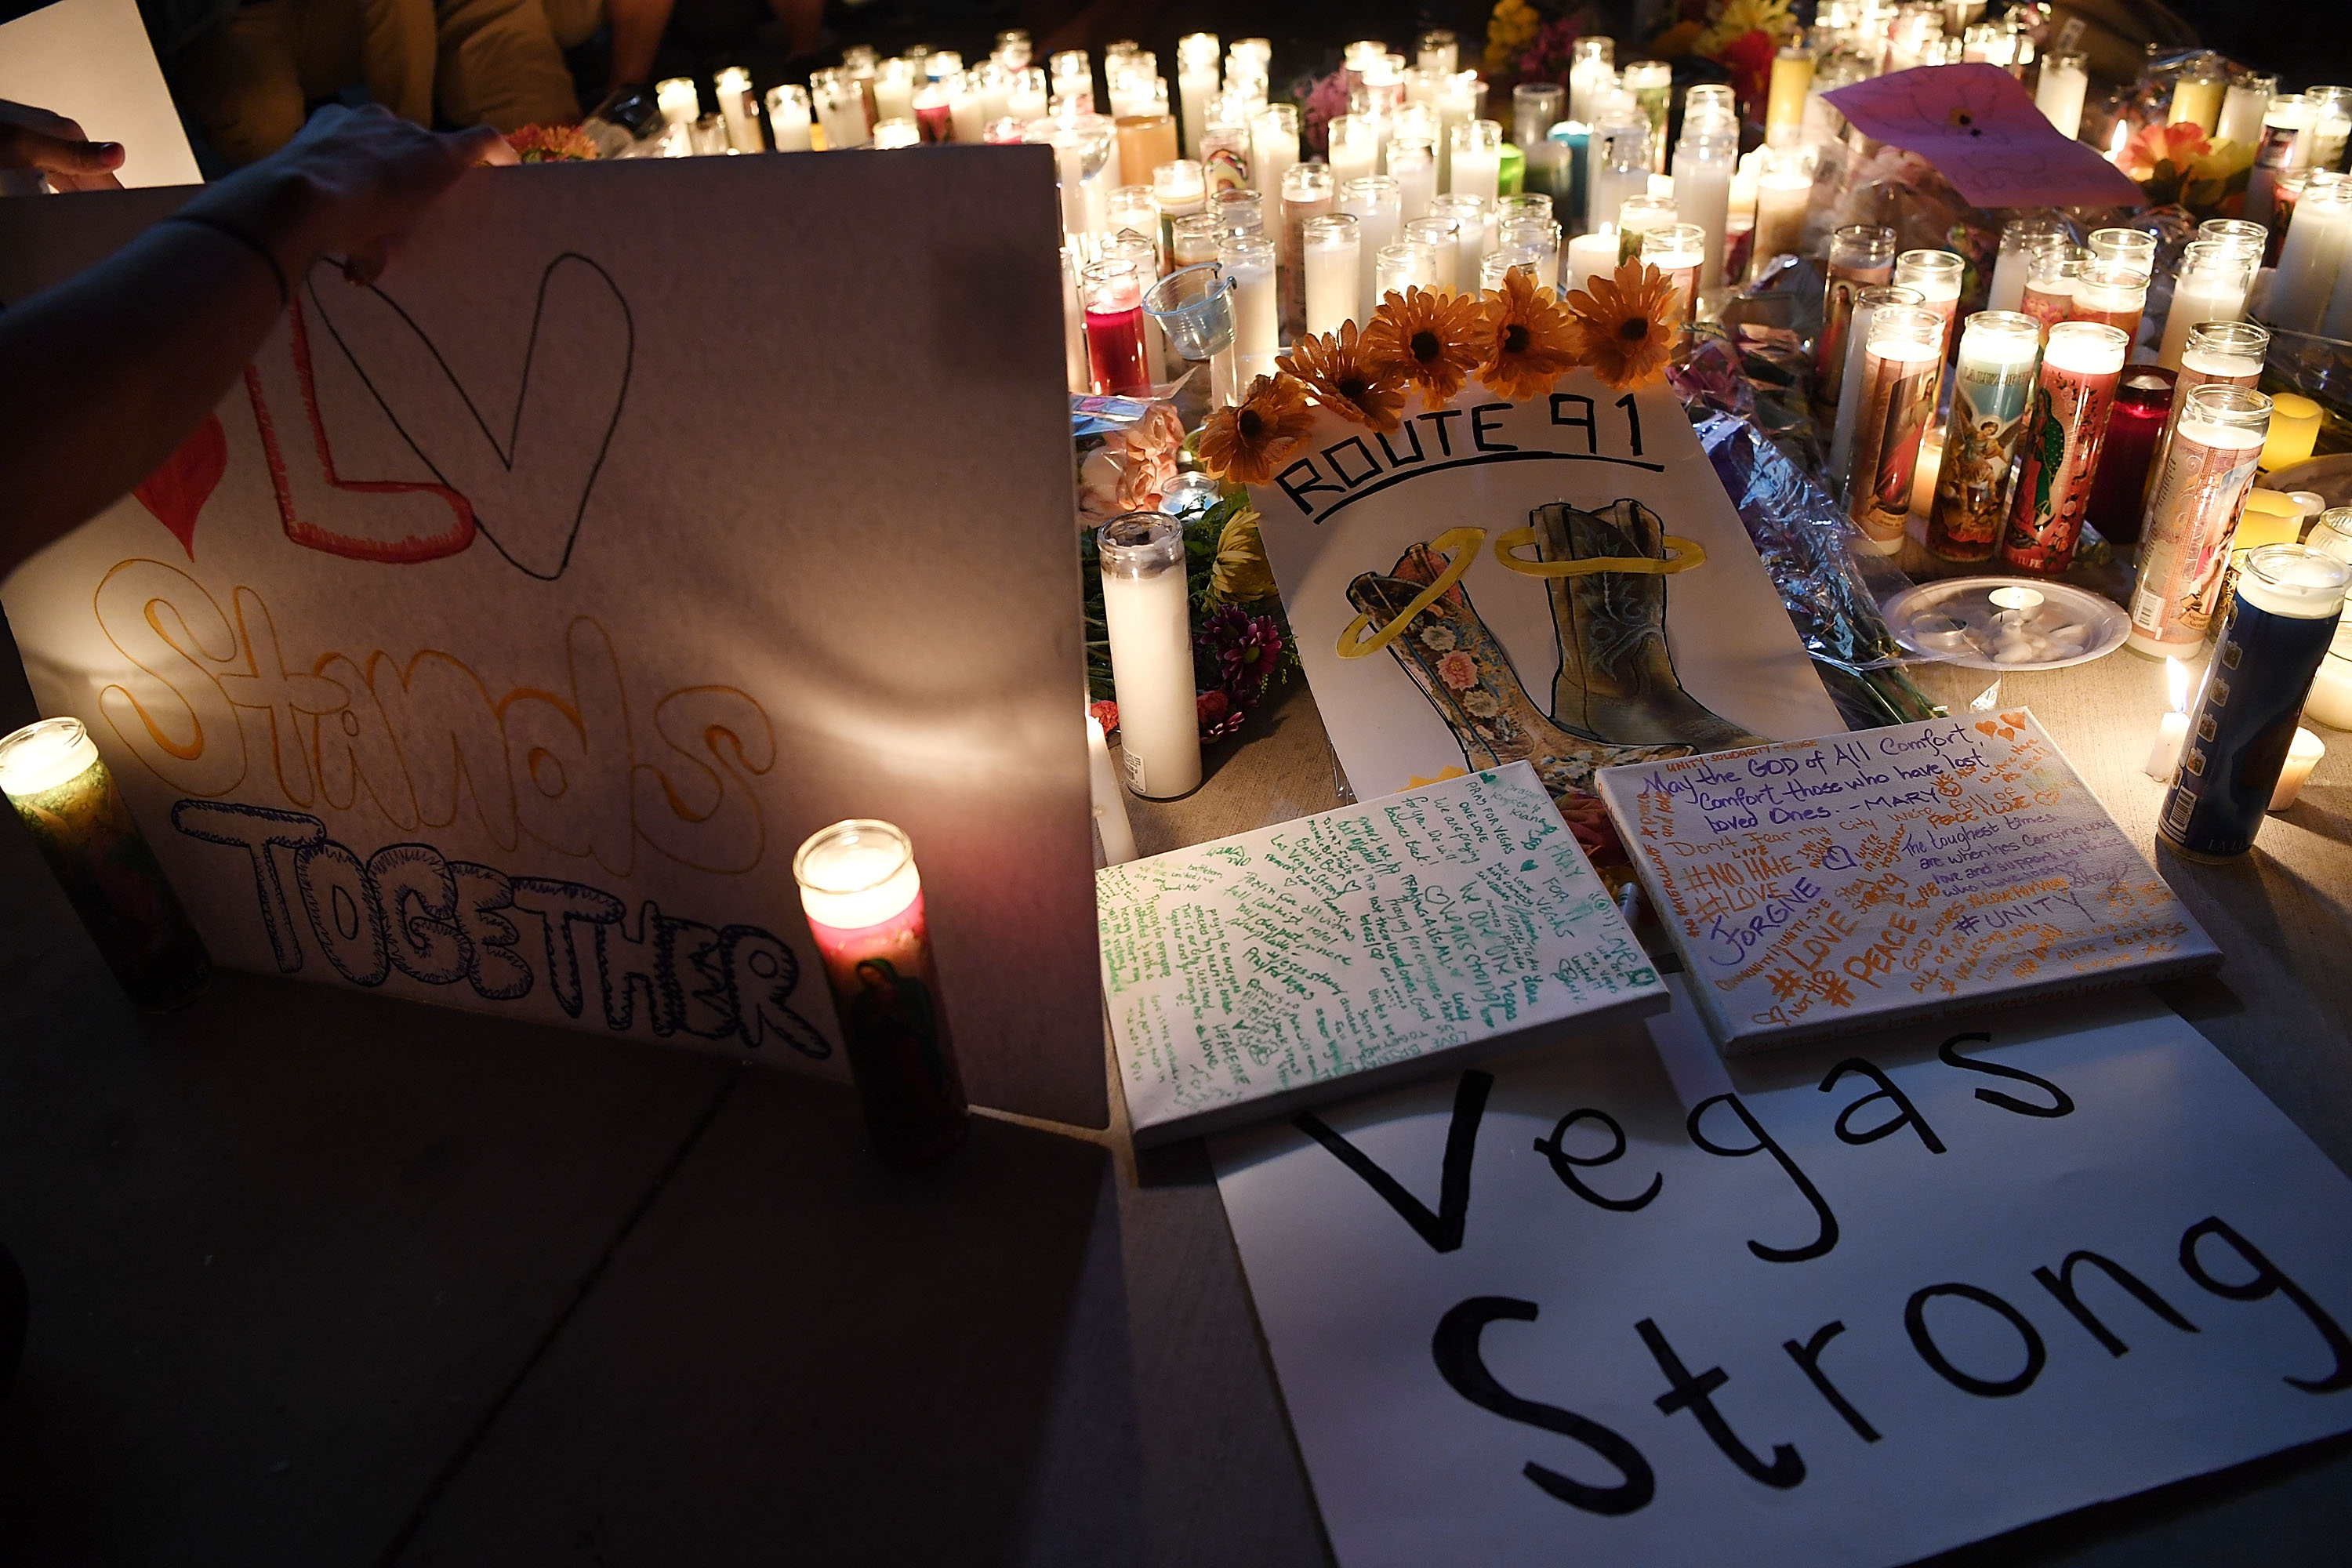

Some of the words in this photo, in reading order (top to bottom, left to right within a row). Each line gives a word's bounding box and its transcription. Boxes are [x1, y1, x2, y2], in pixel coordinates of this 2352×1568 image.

[1275, 402, 1519, 517] ROUTE
[1550, 393, 1644, 457] 91
[93, 558, 775, 876] Stands
[1643, 771, 1700, 804] May
[1695, 764, 1743, 786] the
[1747, 757, 1799, 778] GOD
[1804, 750, 1828, 775] of
[1835, 740, 1871, 768] All
[1699, 783, 1784, 820] Comfort
[1781, 778, 1843, 802] those
[1844, 769, 1891, 791] who
[1892, 762, 1945, 782] have
[1433, 797, 1450, 813] We
[1443, 816, 1463, 832] are
[1458, 801, 1476, 819] ONE
[1469, 820, 1488, 843] LOVE
[1465, 781, 1486, 805] PRAY
[1482, 807, 1499, 826] FOR
[1493, 825, 1515, 854] VEGAS
[1901, 833, 1928, 857] The
[1928, 821, 2001, 851] toughest
[2003, 814, 2057, 830] times
[1427, 829, 1442, 842] We
[1436, 844, 1457, 860] will
[1919, 856, 1946, 870] are
[1947, 847, 1991, 866] when
[1270, 833, 1287, 851] Las
[1287, 848, 1316, 874] Vegas
[1311, 873, 1343, 900] Strong
[1319, 858, 1348, 880] Born
[1679, 862, 1745, 893] #NO
[1742, 855, 1802, 881] HATE
[1964, 863, 1992, 879] and
[1368, 895, 1385, 913] lost
[1459, 880, 1481, 904] We
[1542, 877, 1569, 903] FOR
[1693, 881, 1792, 924] #LOVE
[1941, 884, 1979, 898] who
[172, 799, 831, 1059] TOGETHER
[1143, 894, 1160, 927] Praying
[1153, 927, 1166, 938] for
[1420, 917, 1437, 927] 4
[1425, 927, 1443, 944] US
[1439, 901, 1476, 950] Vegas
[1536, 896, 1574, 937] VEGAS
[1219, 942, 1230, 953] for
[1764, 909, 1860, 1003] #LOVE
[1821, 910, 1918, 1009] #PEACE
[1901, 938, 1933, 972] GOD
[1290, 1029, 2076, 1264] Vegas
[1431, 1214, 2352, 1519] Strong
